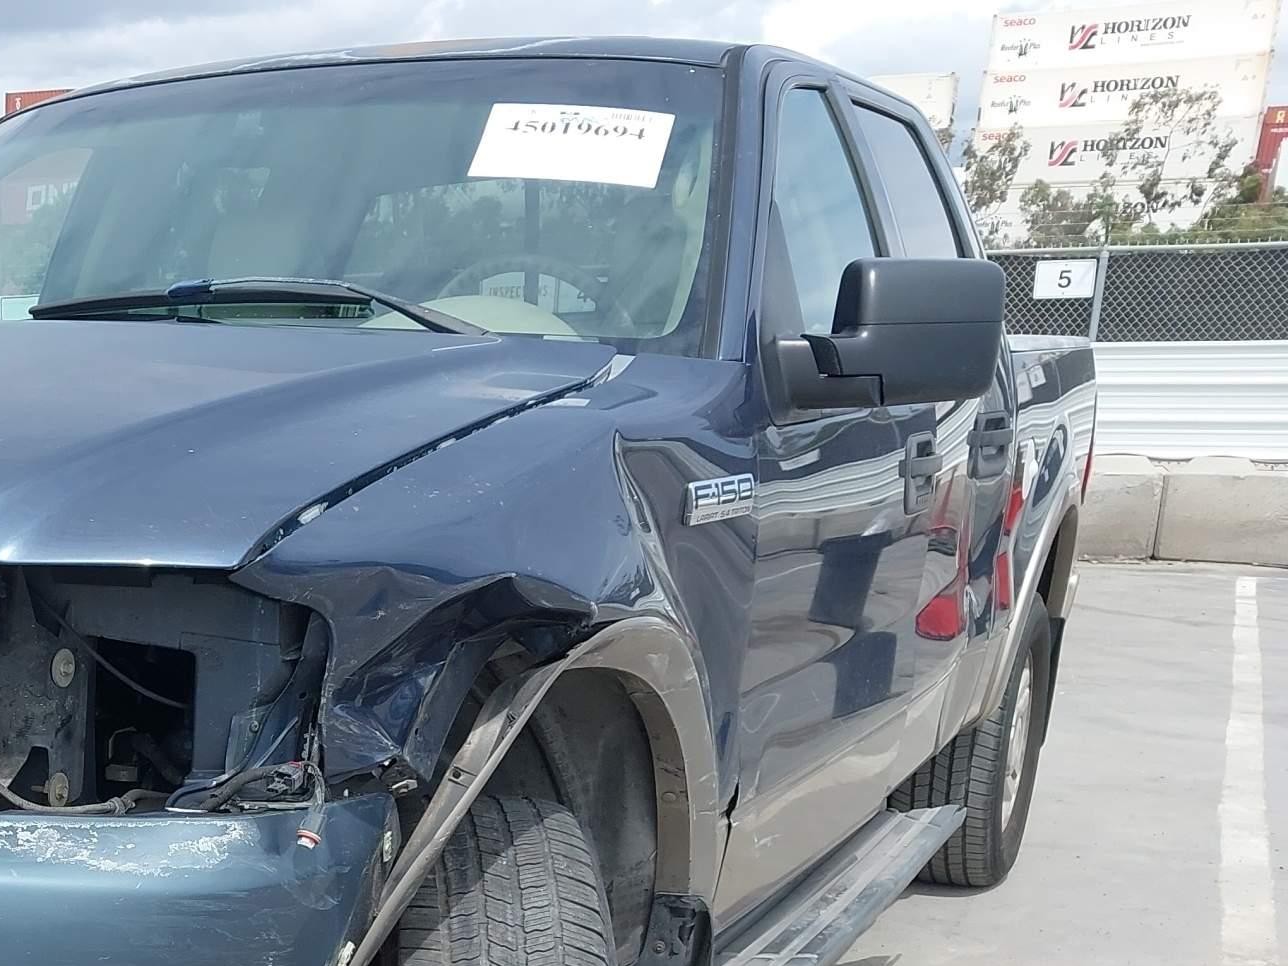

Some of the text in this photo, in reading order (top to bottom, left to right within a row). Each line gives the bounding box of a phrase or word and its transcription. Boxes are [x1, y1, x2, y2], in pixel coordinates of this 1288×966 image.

[1003, 17, 1037, 28] seaco
[1103, 14, 1192, 35] HORIZON
[1100, 31, 1175, 45] LINES
[993, 74, 1027, 84] seaco
[1093, 75, 1180, 93] HORIZON
[505, 119, 646, 140] 45019694
[1057, 270, 1072, 288] 5
